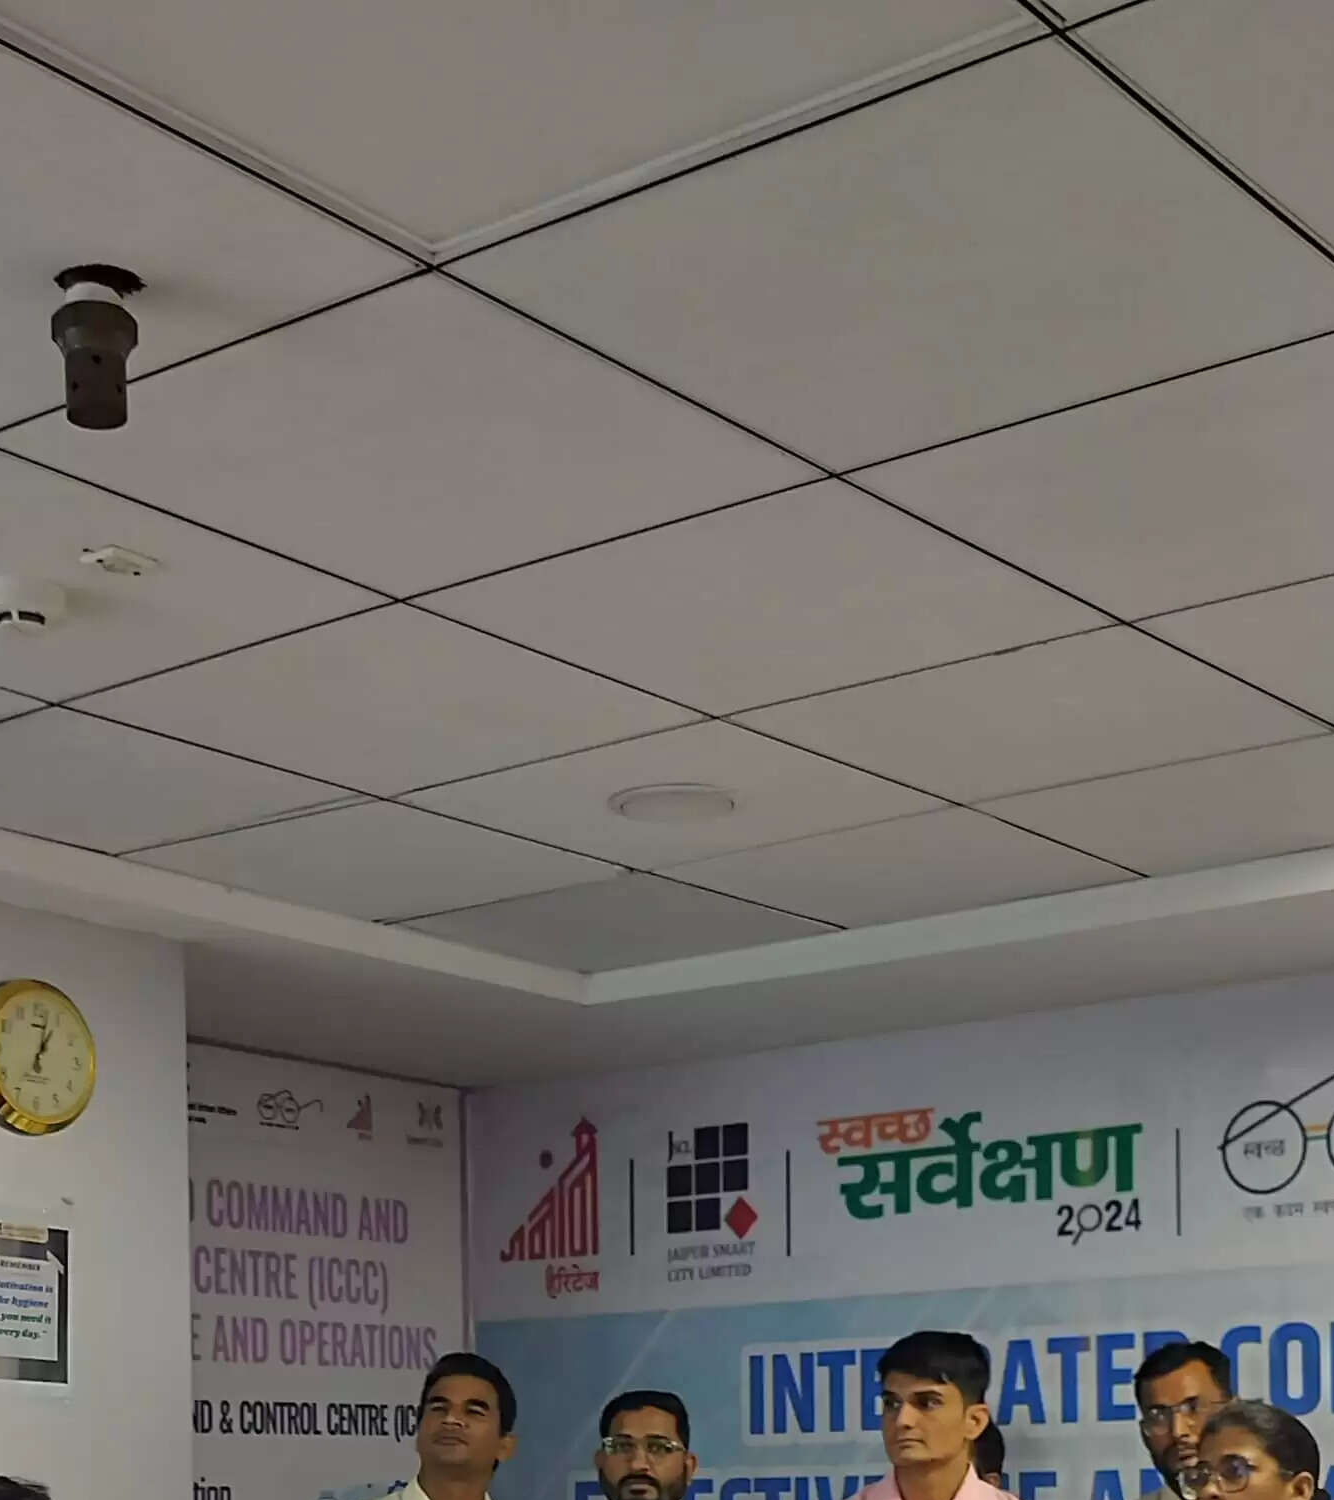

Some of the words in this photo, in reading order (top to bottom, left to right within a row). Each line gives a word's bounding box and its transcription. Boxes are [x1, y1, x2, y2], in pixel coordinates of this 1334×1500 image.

[817, 1107, 934, 1154] स्वच्छ
[837, 1111, 1143, 1220] सर्वेक्षण
[206, 1178, 348, 1239] COMMAND
[358, 1195, 409, 1244] AND
[193, 1245, 299, 1300] CENTRE
[308, 1255, 389, 1316] (ICCC)
[212, 1315, 268, 1363] AND
[279, 1318, 437, 1371] OPERATIONS
[219, 1400, 234, 1434] &
[239, 1400, 321, 1436] CONTROL
[326, 1402, 389, 1437] CENTRE
[394, 1404, 421, 1442] (IC
